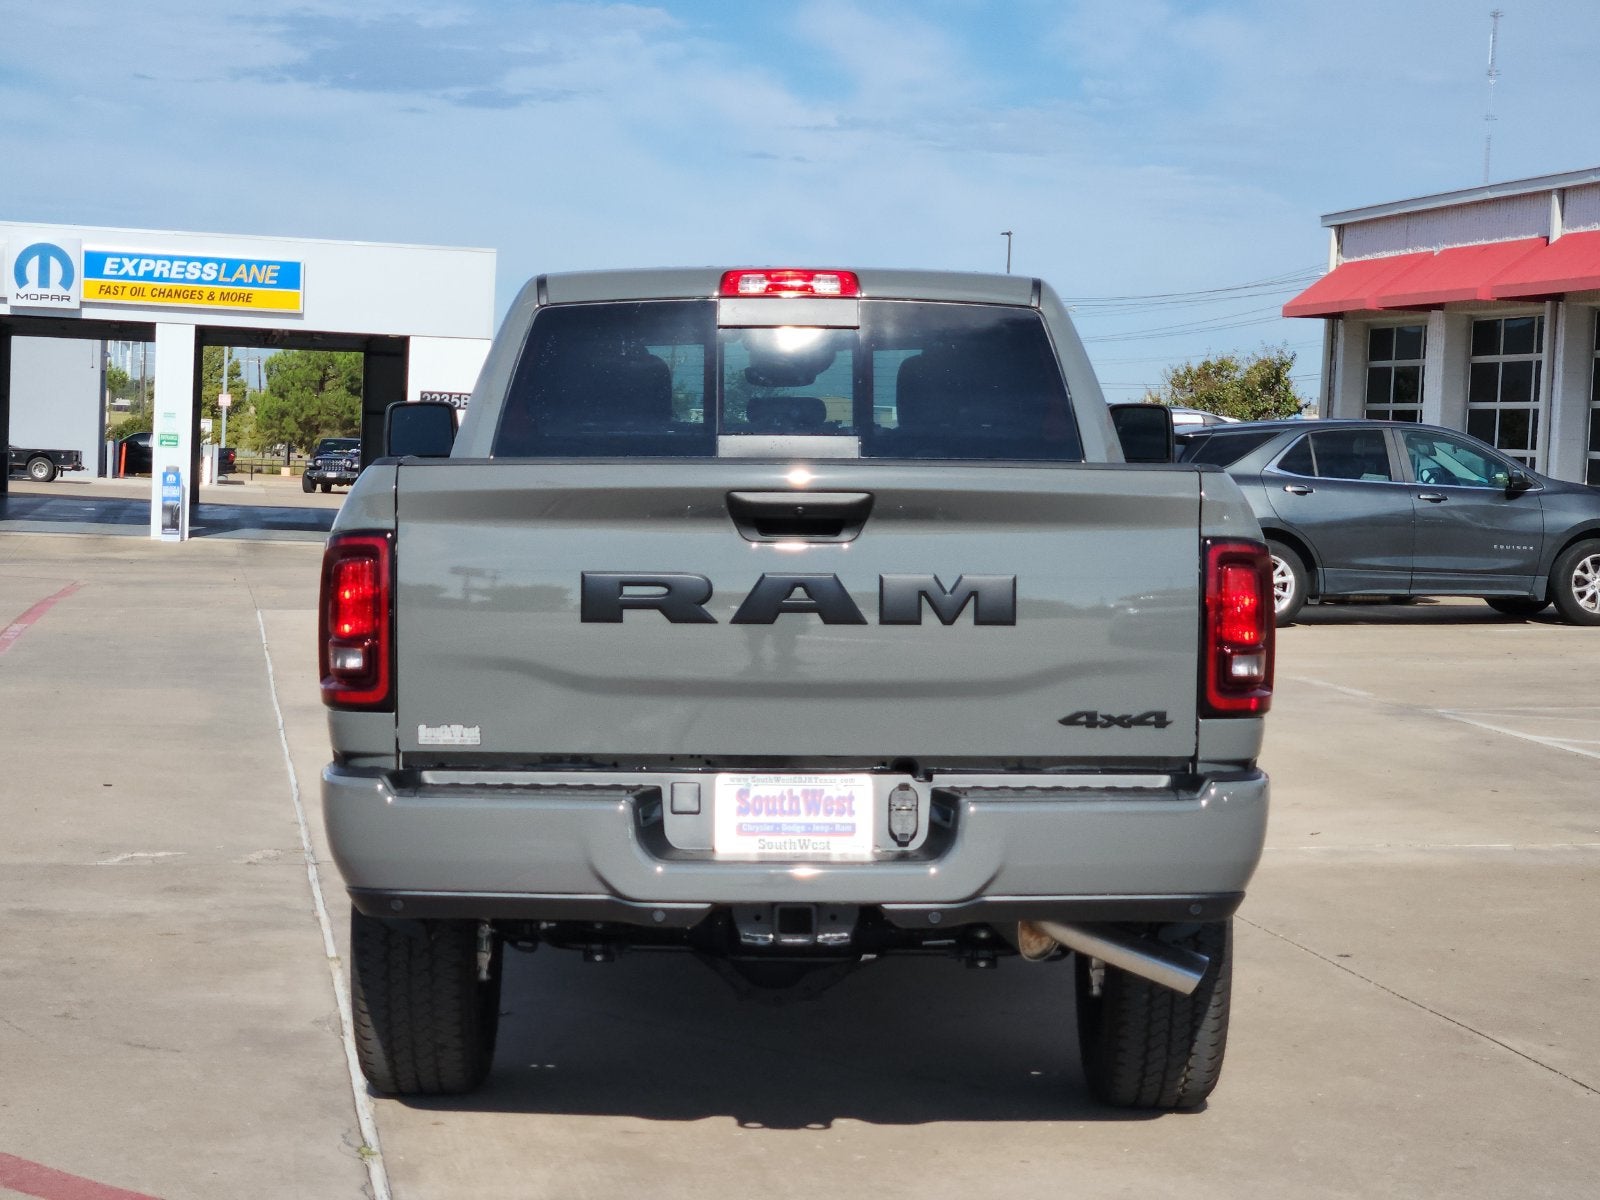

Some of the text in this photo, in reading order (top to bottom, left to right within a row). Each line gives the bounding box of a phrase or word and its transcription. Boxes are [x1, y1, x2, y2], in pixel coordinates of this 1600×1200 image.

[15, 292, 71, 302] MOPAR
[98, 284, 253, 303] FAST OIL CHANGES & MORE
[581, 571, 1016, 626] RAM
[1058, 710, 1173, 728] 4x4
[758, 838, 831, 850] SouthWest
